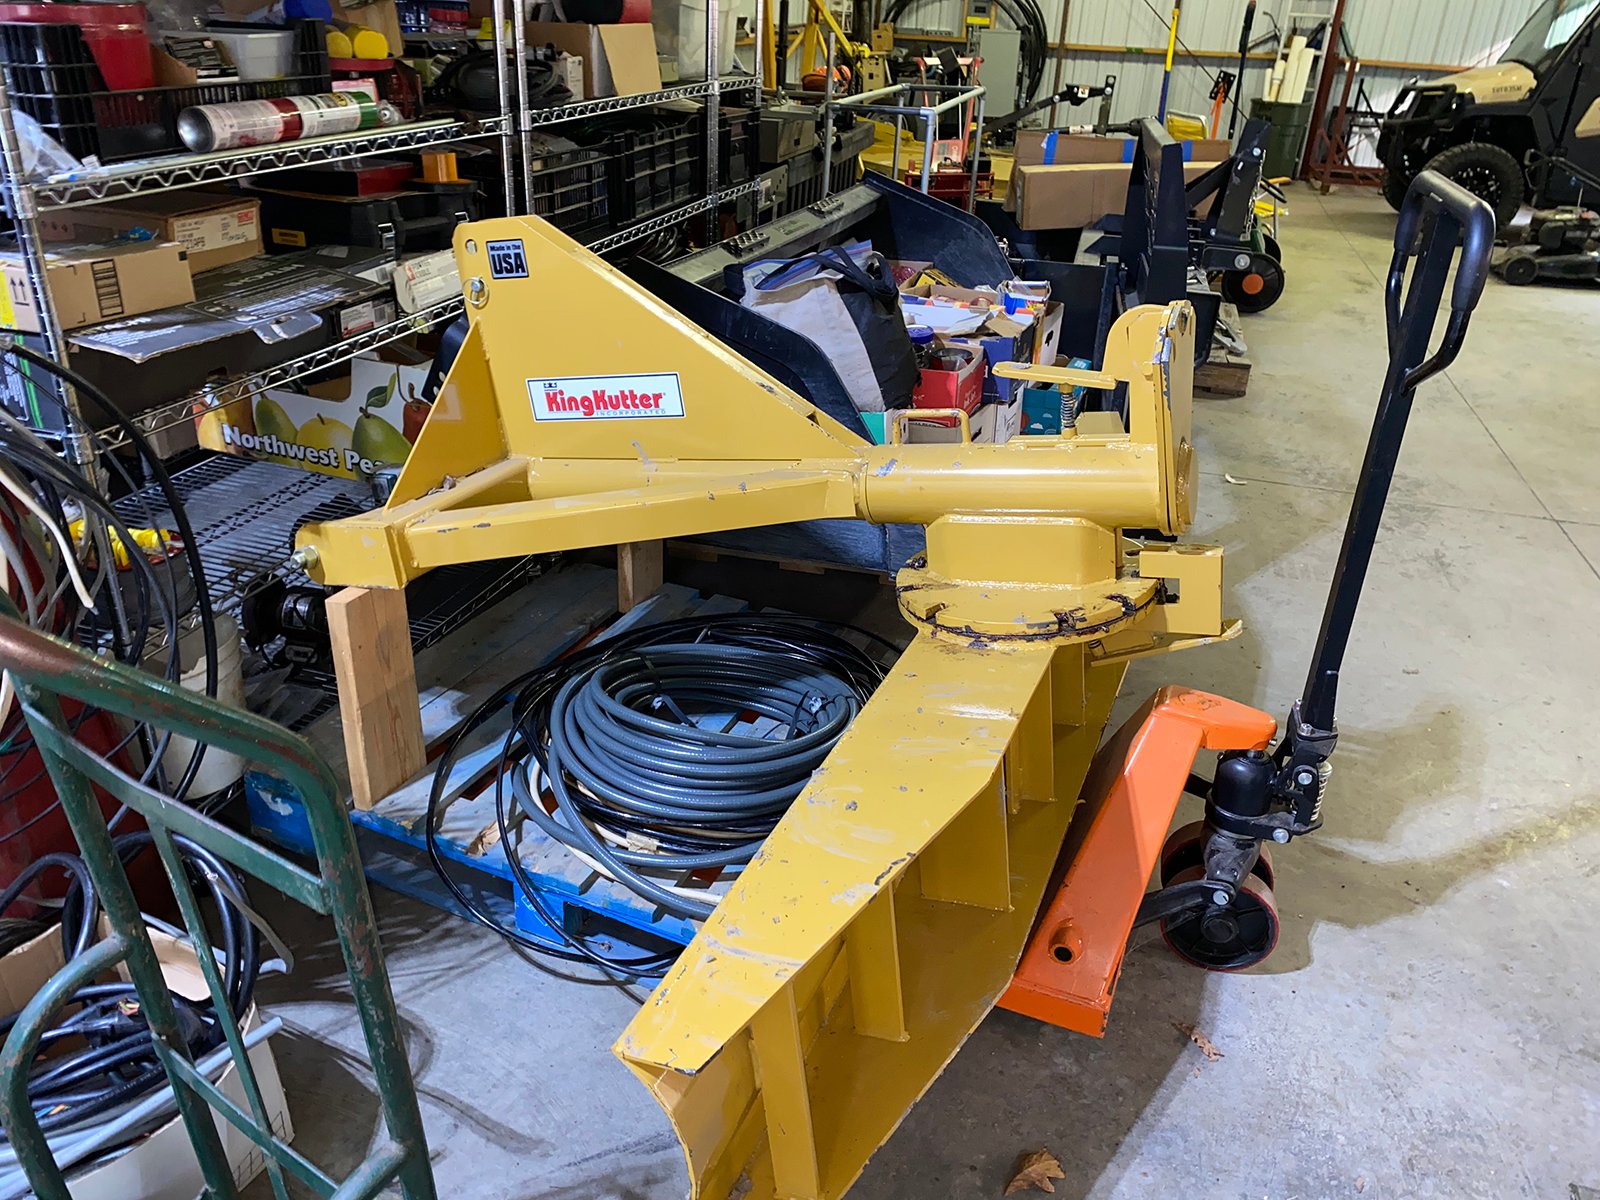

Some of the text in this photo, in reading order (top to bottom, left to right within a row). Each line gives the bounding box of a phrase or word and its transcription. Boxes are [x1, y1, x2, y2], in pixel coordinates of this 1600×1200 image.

[491, 252, 526, 275] USA
[545, 389, 664, 417] KingKutter
[596, 408, 667, 417] INCORPORATED
[221, 423, 340, 468] Northwest
